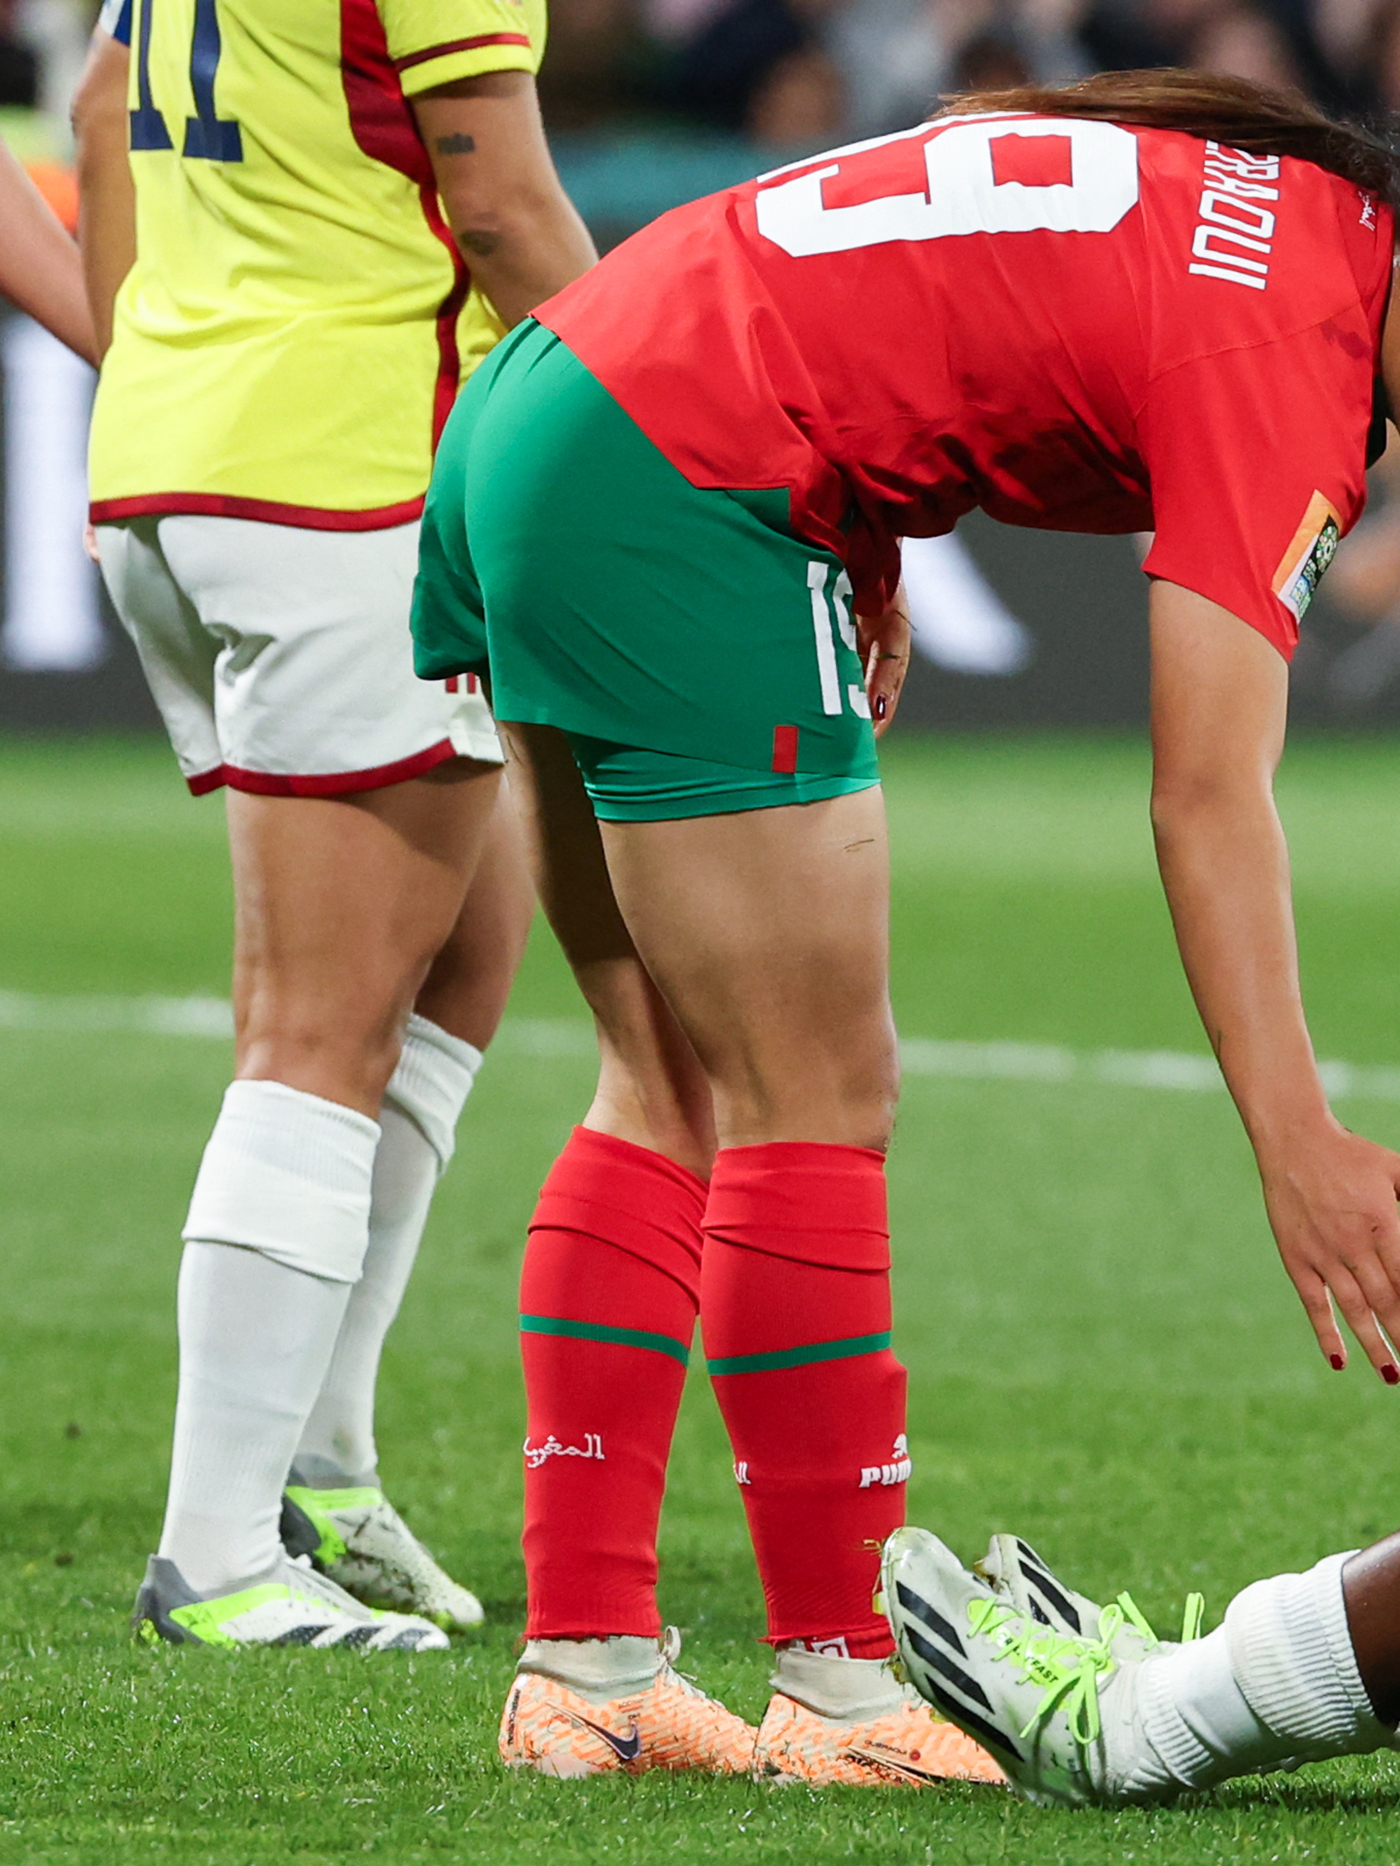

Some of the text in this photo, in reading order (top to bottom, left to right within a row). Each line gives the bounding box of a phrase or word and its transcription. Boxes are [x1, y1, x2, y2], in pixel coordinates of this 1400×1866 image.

[754, 111, 1139, 259] 9
[523, 1433, 606, 1469] المغرب
[858, 1458, 912, 1489] PUM
[997, 1632, 1059, 1684] CRYFAST
